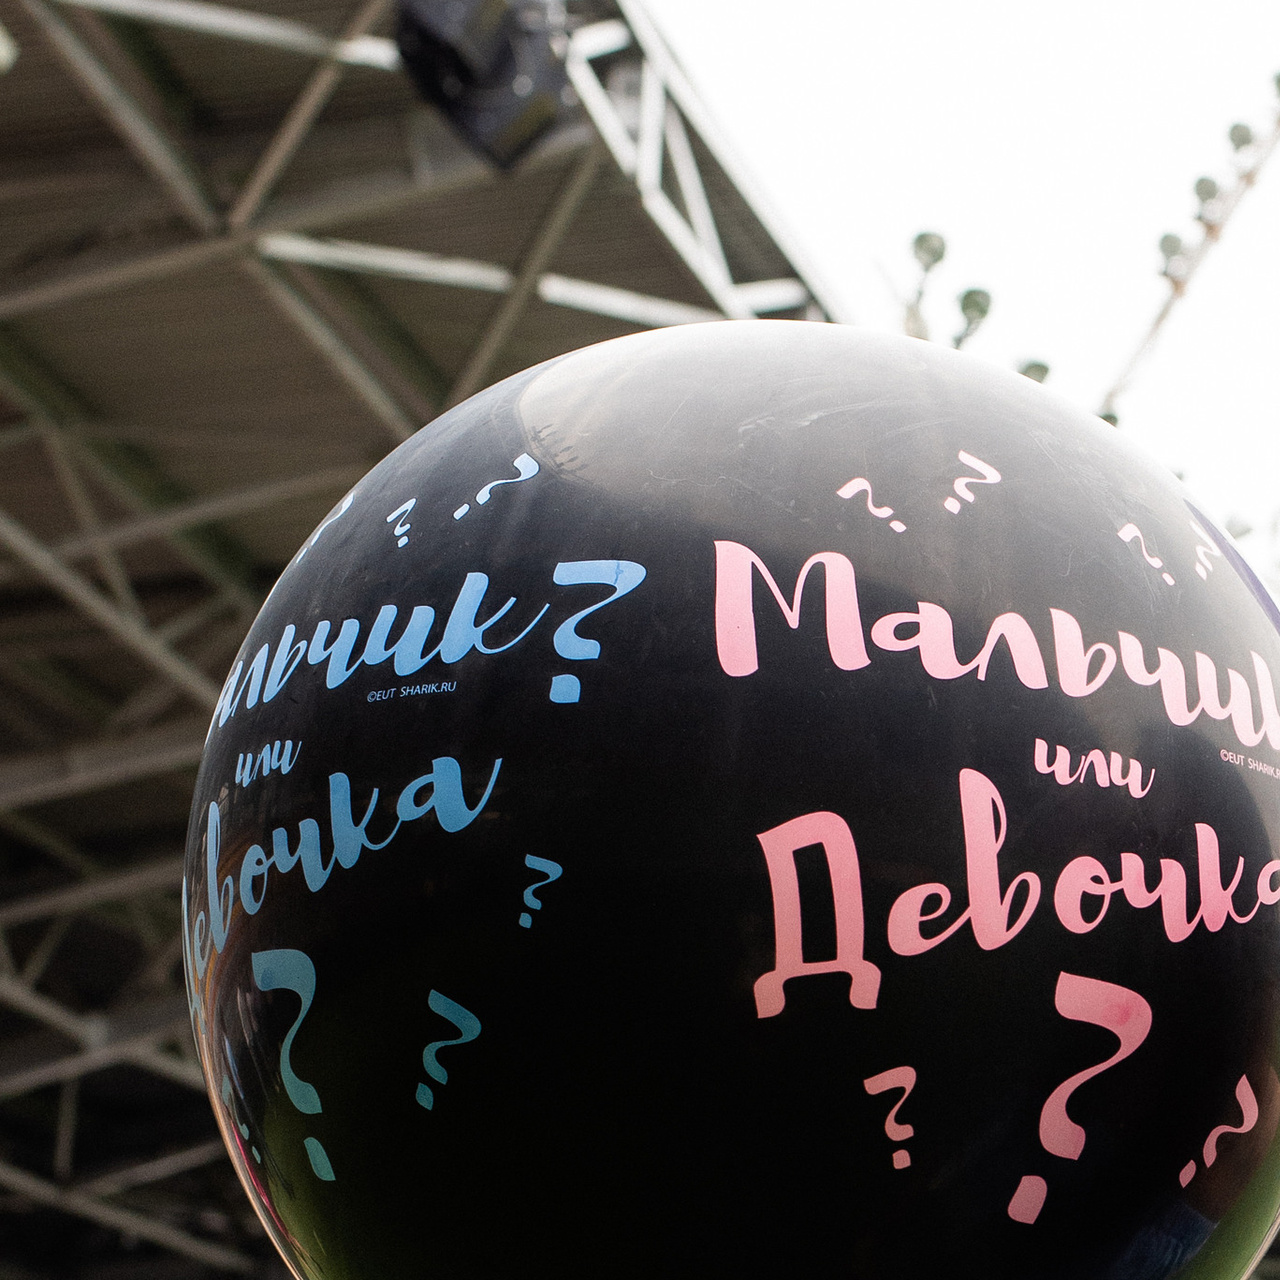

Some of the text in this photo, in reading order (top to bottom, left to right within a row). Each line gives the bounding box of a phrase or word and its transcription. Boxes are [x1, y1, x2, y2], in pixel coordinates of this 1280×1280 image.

[205, 559, 647, 735] альчик?
[399, 680, 458, 698] SHARIK.RU
[235, 739, 303, 788] или
[1034, 737, 1156, 799] или
[182, 756, 503, 1035] евочка
